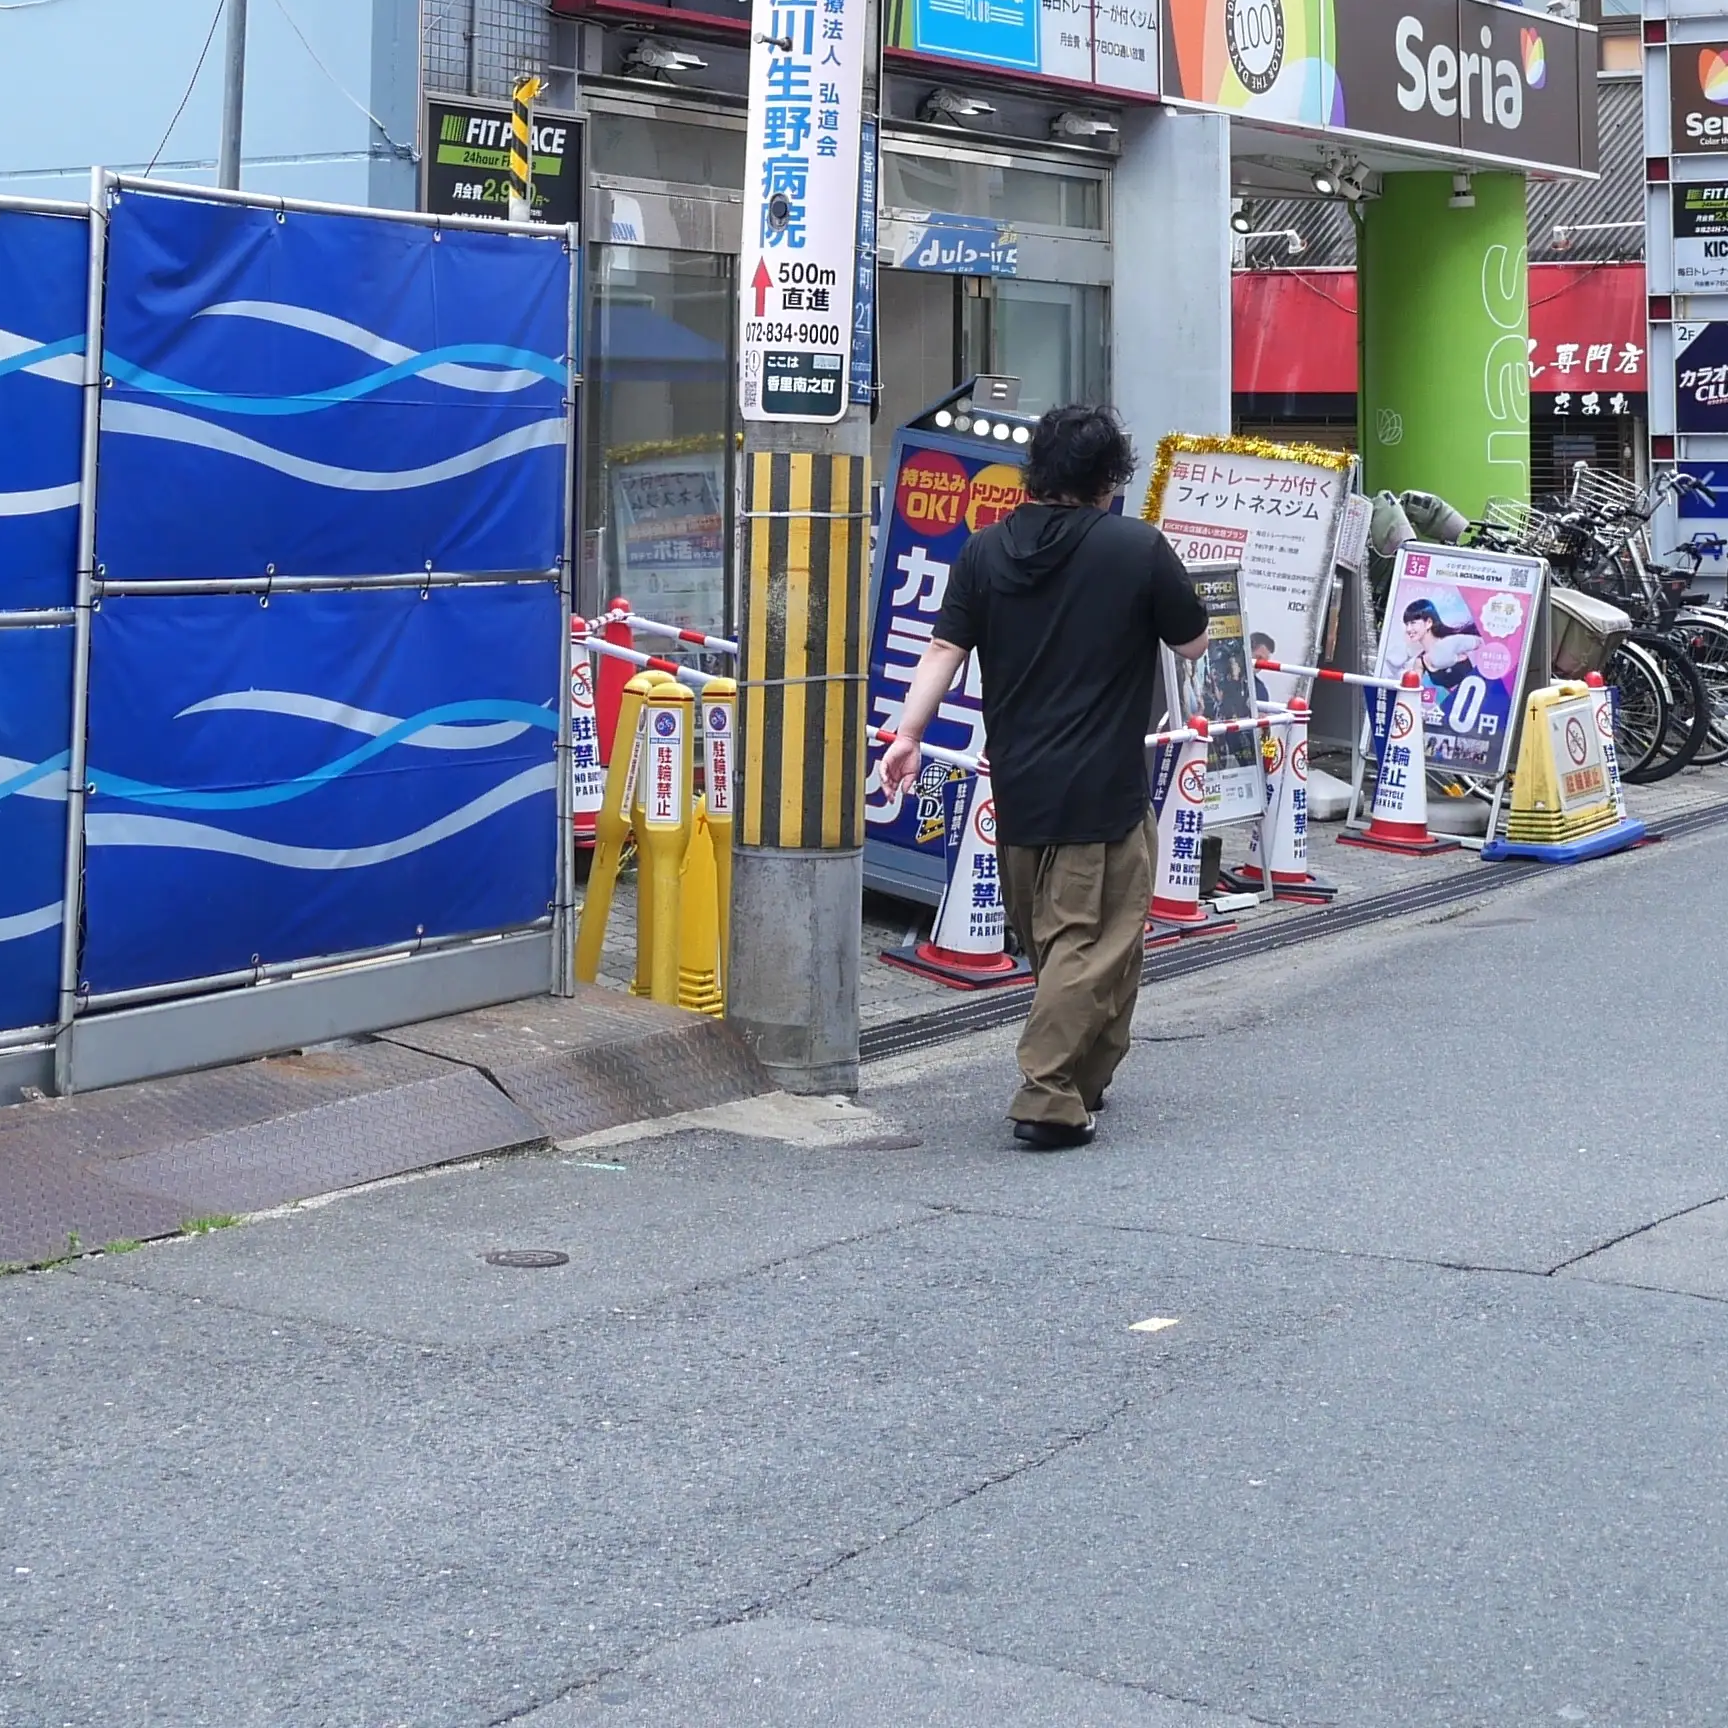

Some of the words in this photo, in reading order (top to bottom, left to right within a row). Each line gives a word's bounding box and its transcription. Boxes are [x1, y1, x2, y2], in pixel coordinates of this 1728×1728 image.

[1235, 3, 1274, 52] 100
[1395, 15, 1523, 130] Seria
[816, 82, 840, 158] 弘道会
[466, 117, 500, 145] FIT
[499, 121, 567, 154] PACE
[1699, 135, 1720, 145] Color
[1702, 188, 1724, 200] FIT
[778, 262, 836, 286] 500m
[781, 286, 830, 312] 直進
[1677, 326, 1696, 341] 2F
[767, 356, 799, 369] ここは
[767, 375, 836, 394] 香里南之町
[899, 466, 967, 492] 持ち込み
[1172, 461, 1333, 498] 毎日トレーナが付く
[906, 491, 960, 525] OK!
[1178, 486, 1319, 520] フィットネスジム
[1409, 560, 1426, 576] 3F
[655, 746, 673, 818] 駐輪禁止
[712, 740, 728, 810] 駐輪禁止
